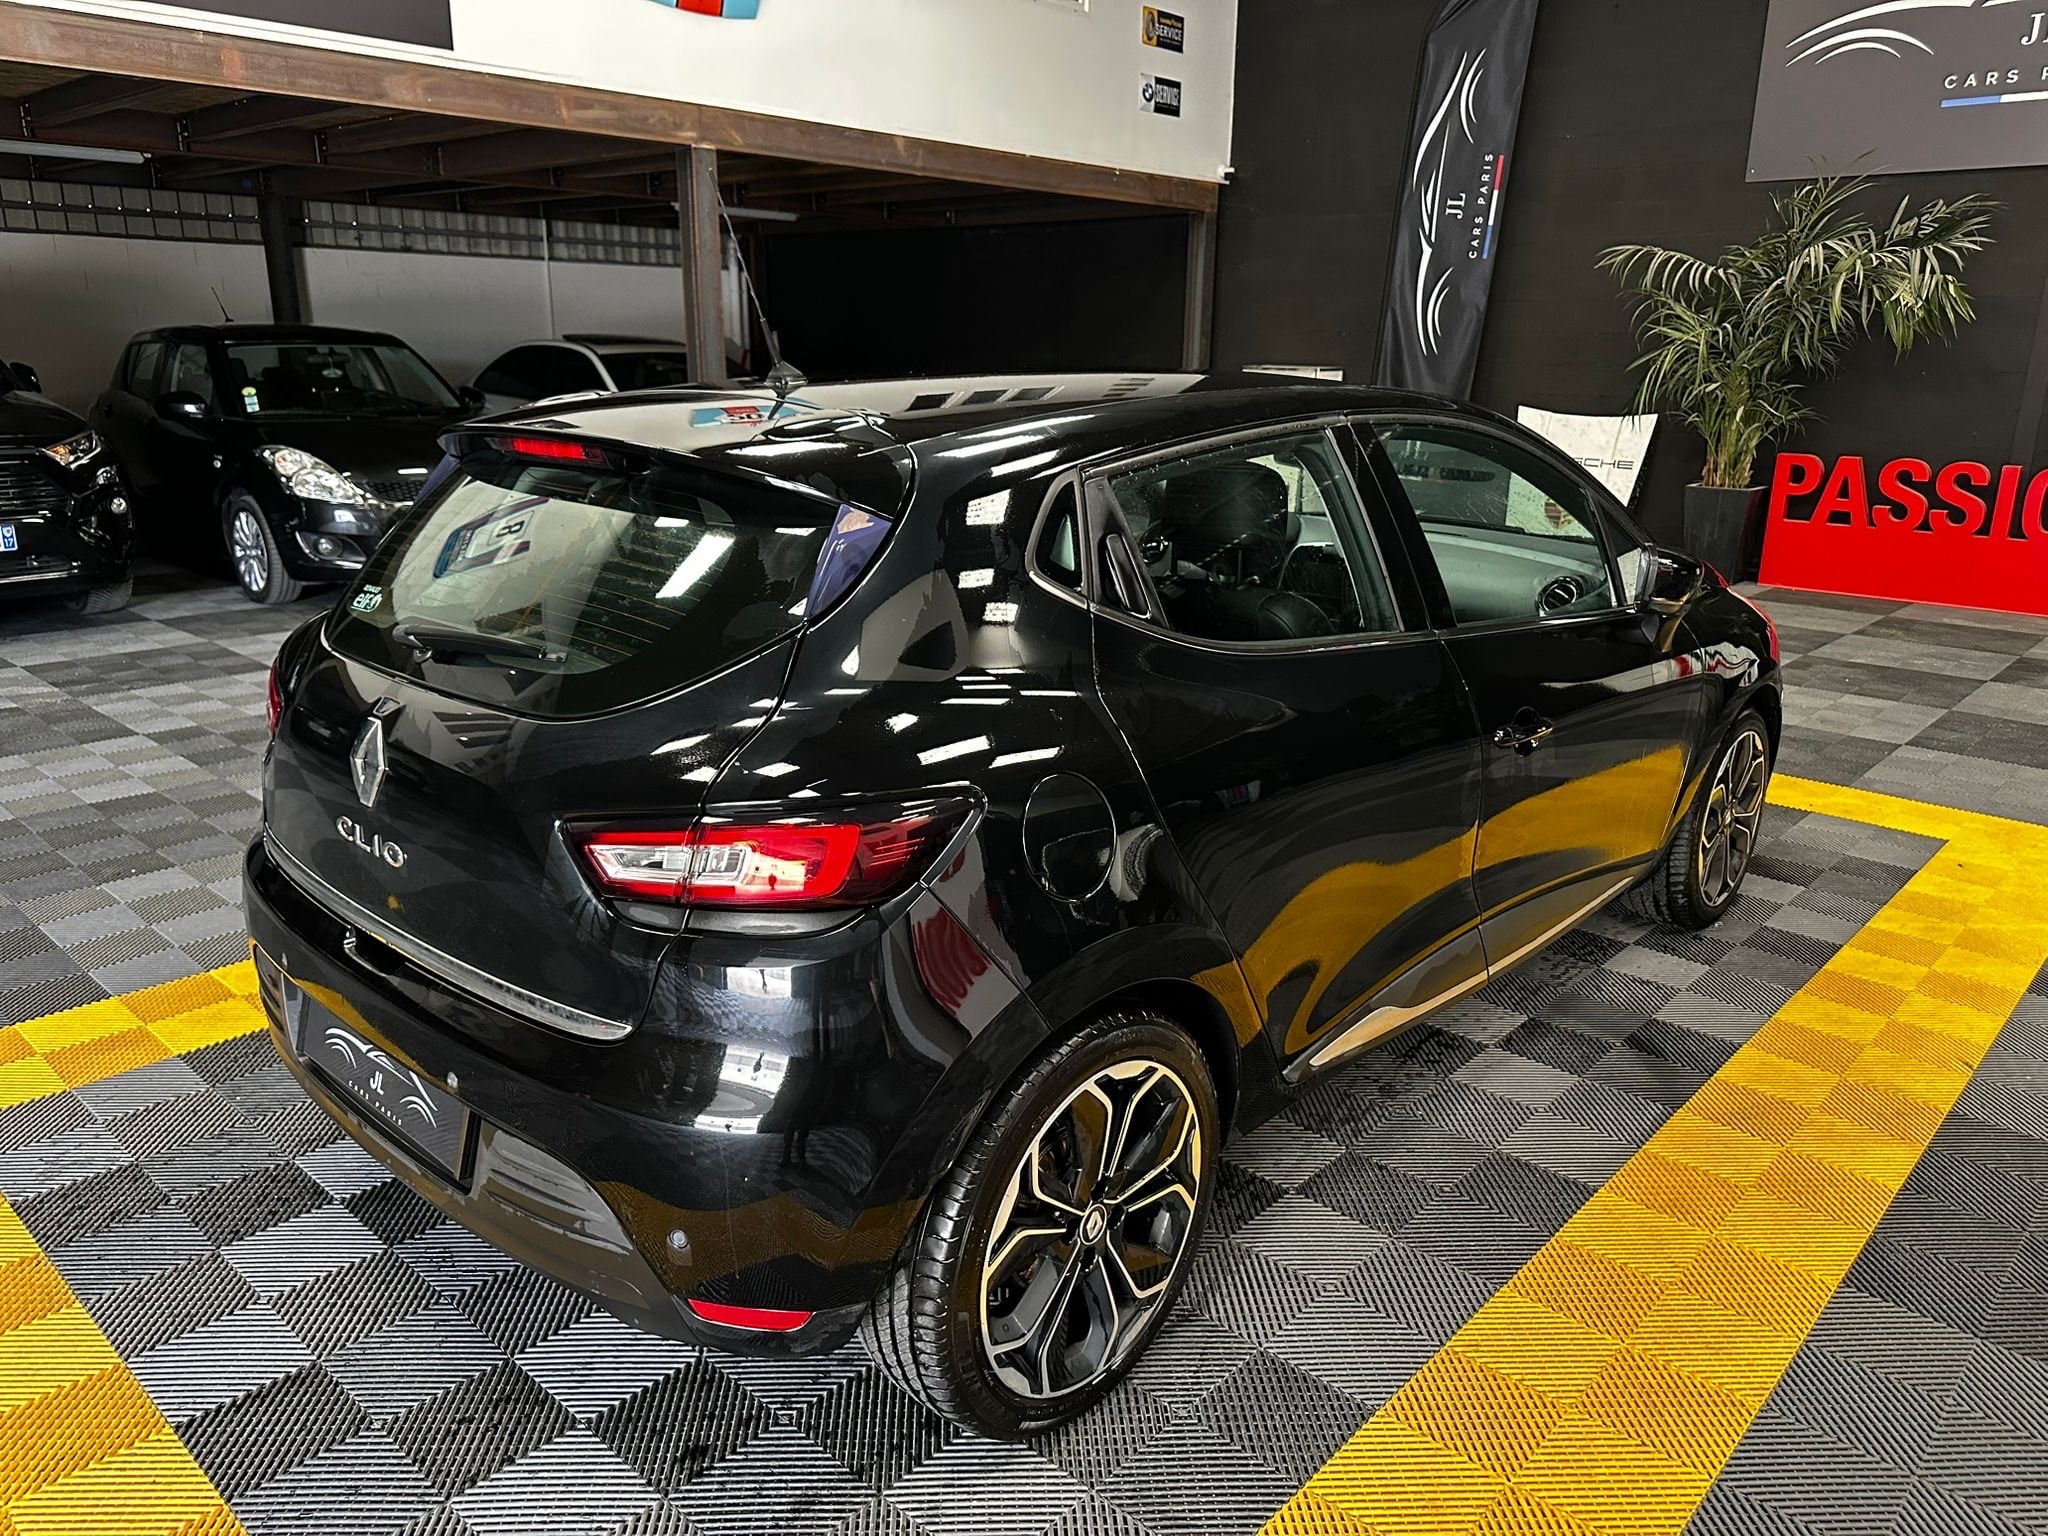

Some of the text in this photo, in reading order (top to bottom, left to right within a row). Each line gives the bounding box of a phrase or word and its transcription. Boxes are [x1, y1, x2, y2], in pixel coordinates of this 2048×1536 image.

[2020, 12, 2048, 46] J
[1944, 69, 2019, 89] CARS
[1445, 192, 1466, 219] JL
[1468, 154, 1494, 259] CARS PARIS
[336, 815, 404, 868] CLIO
[369, 1070, 385, 1096] JL
